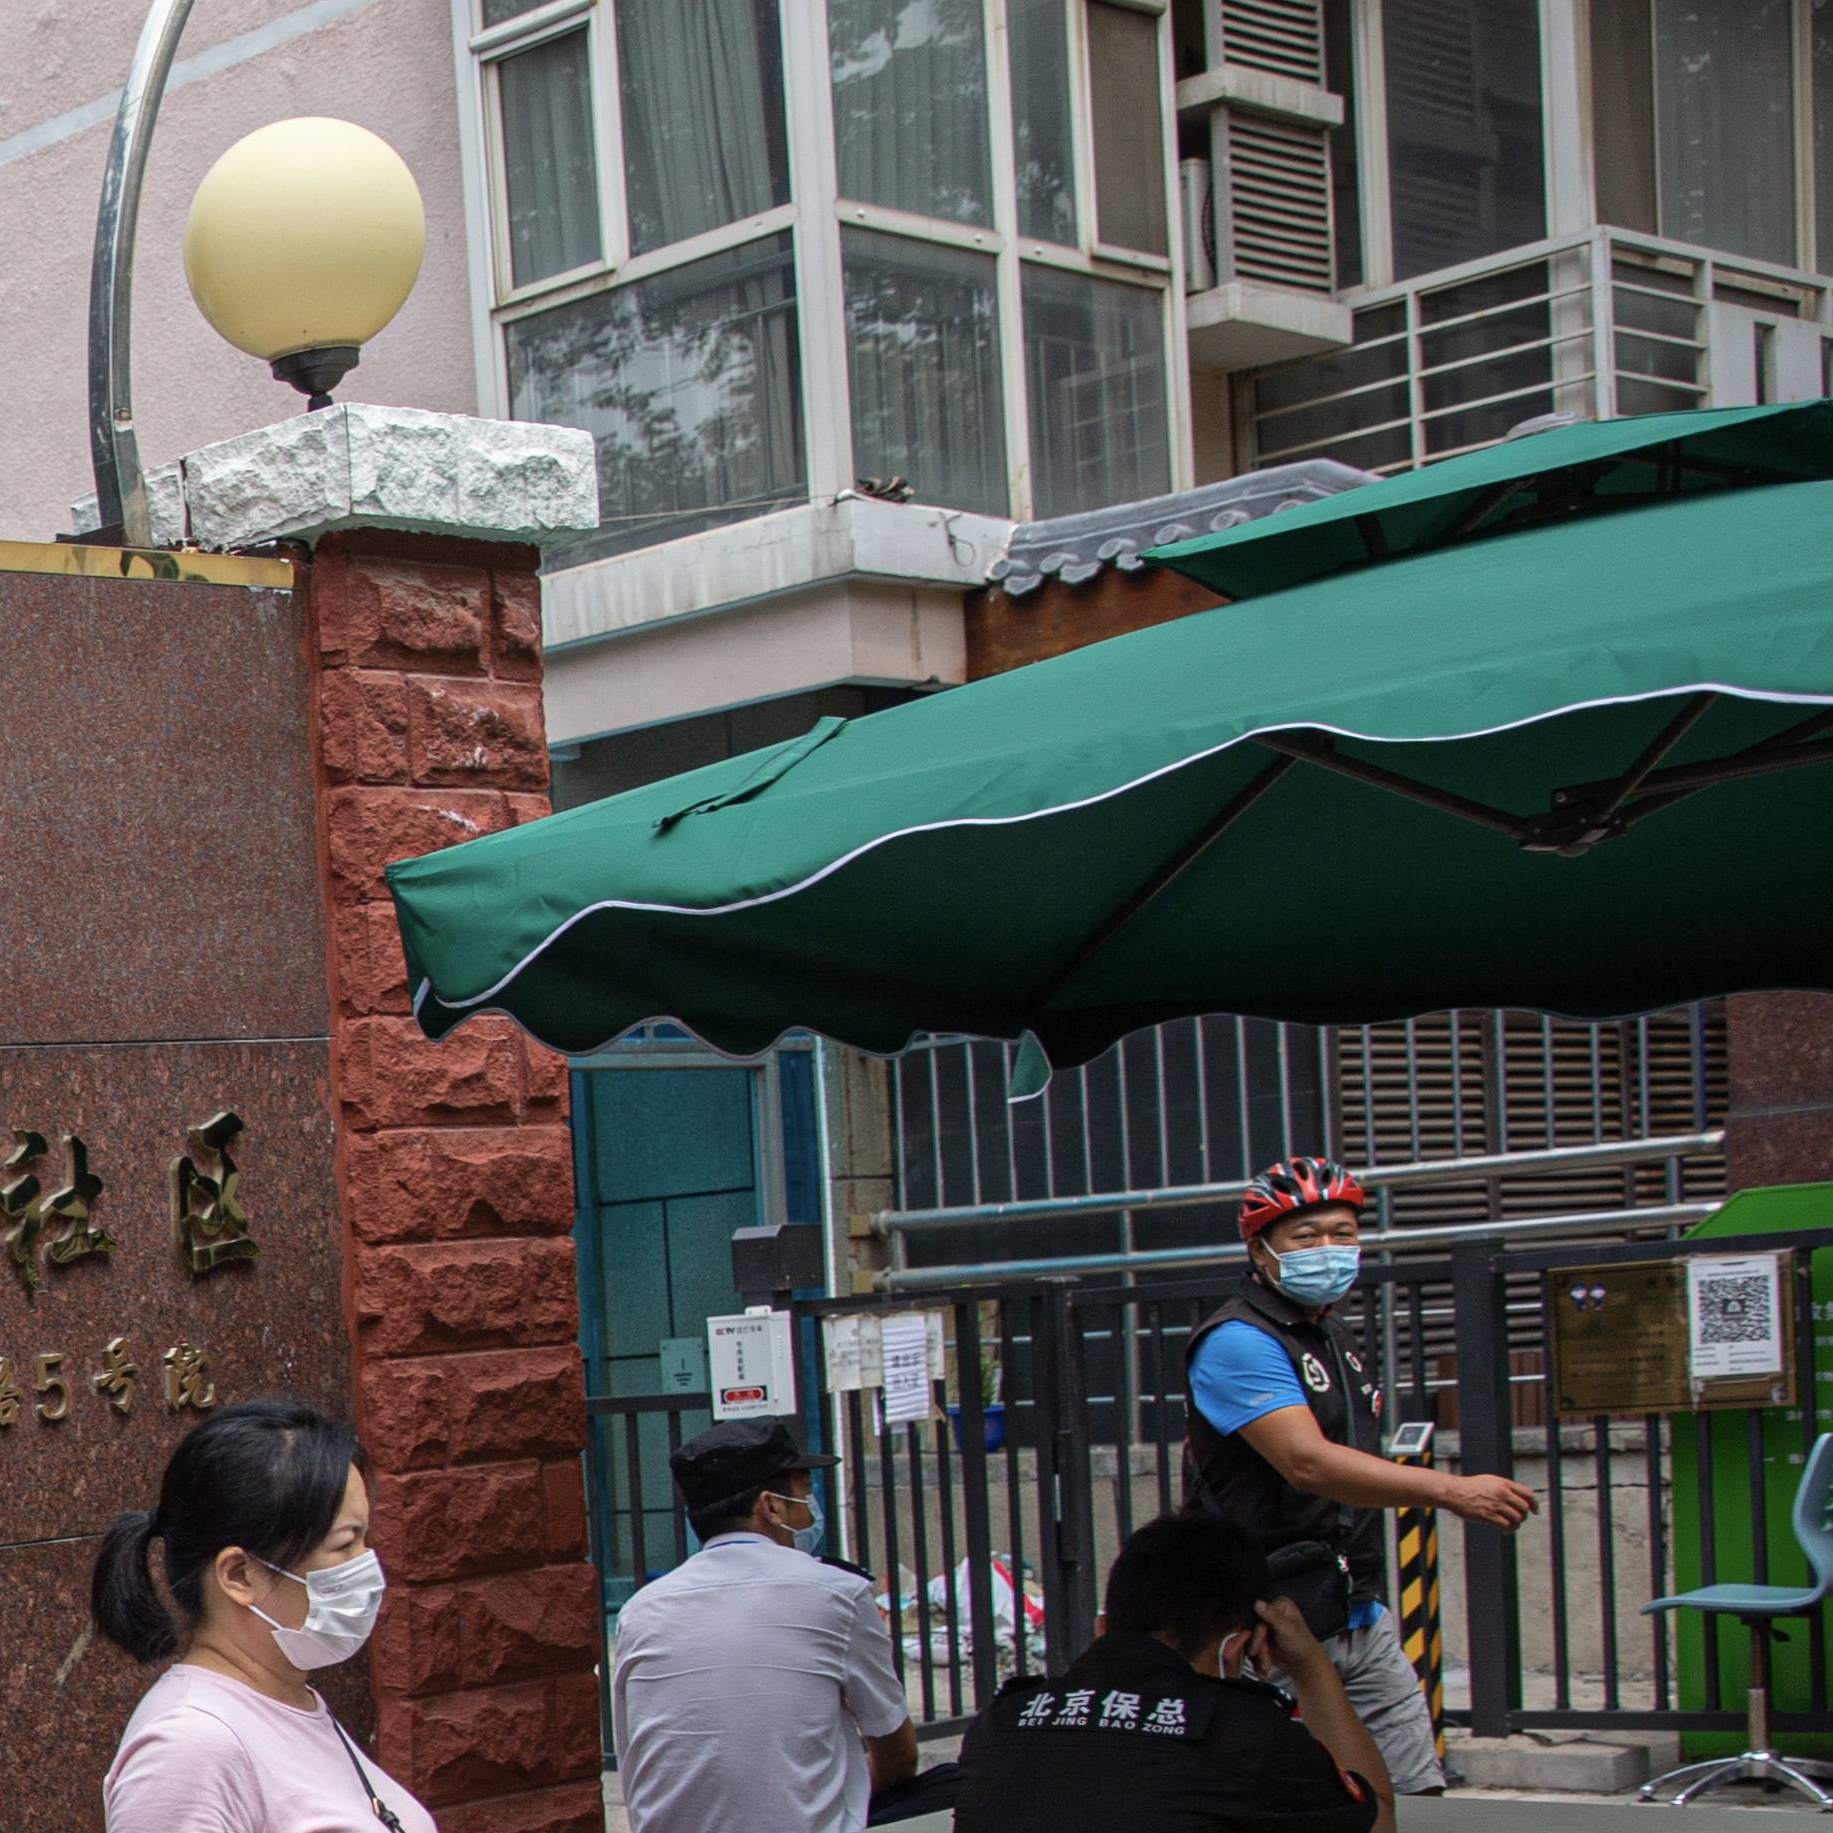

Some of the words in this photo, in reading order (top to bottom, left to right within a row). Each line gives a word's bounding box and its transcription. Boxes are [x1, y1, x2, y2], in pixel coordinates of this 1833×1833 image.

[1020, 1689, 1187, 1726] 北京保总
[1017, 1718, 1044, 1727] BEI
[1051, 1716, 1088, 1727] JING
[1098, 1718, 1137, 1730] BAO
[1141, 1722, 1186, 1735] ZONG
